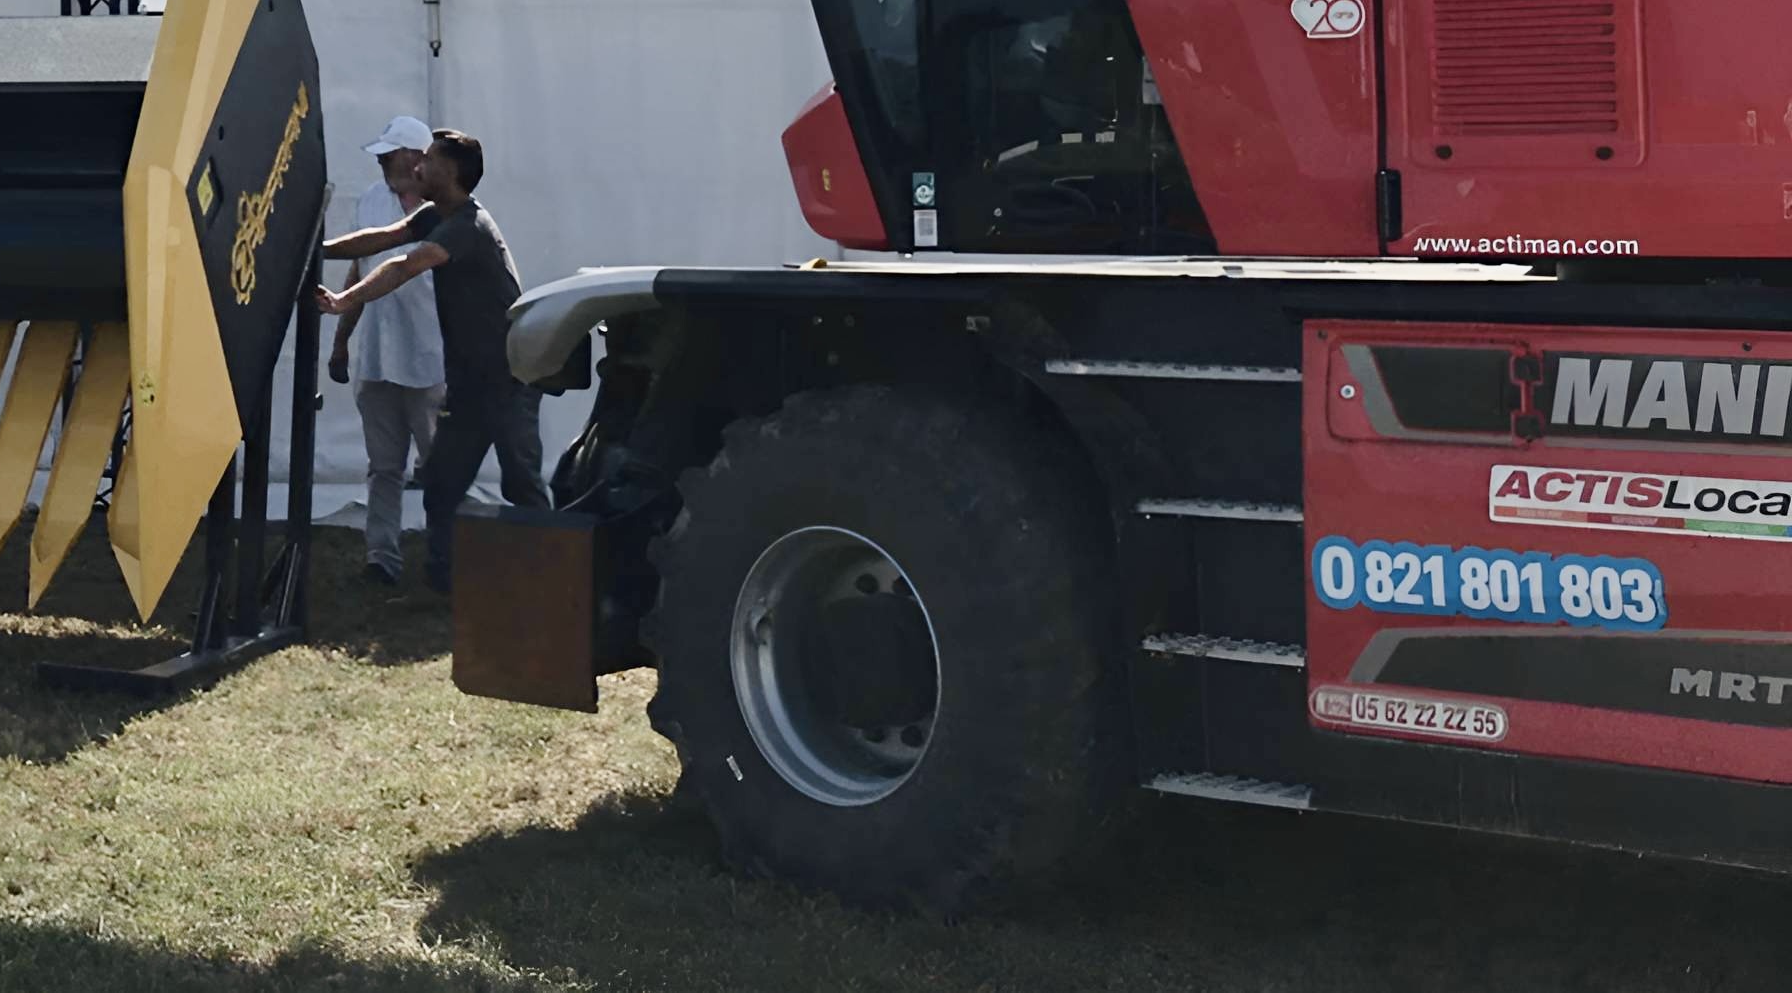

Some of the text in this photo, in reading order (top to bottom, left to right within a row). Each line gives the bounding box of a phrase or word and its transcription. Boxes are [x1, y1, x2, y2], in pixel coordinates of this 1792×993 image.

[1414, 234, 1639, 255] www.actiman.com
[1550, 357, 1792, 437] MANI
[1320, 545, 1355, 600] 0
[1365, 550, 1446, 607] 821
[1460, 557, 1546, 614] 801
[1560, 564, 1657, 623] 803
[1670, 667, 1792, 704] MRT
[1356, 695, 1379, 721] 05
[1385, 700, 1408, 725] 62
[1414, 703, 1437, 728] 22
[1443, 707, 1467, 732] 22
[1473, 710, 1497, 735] 55
